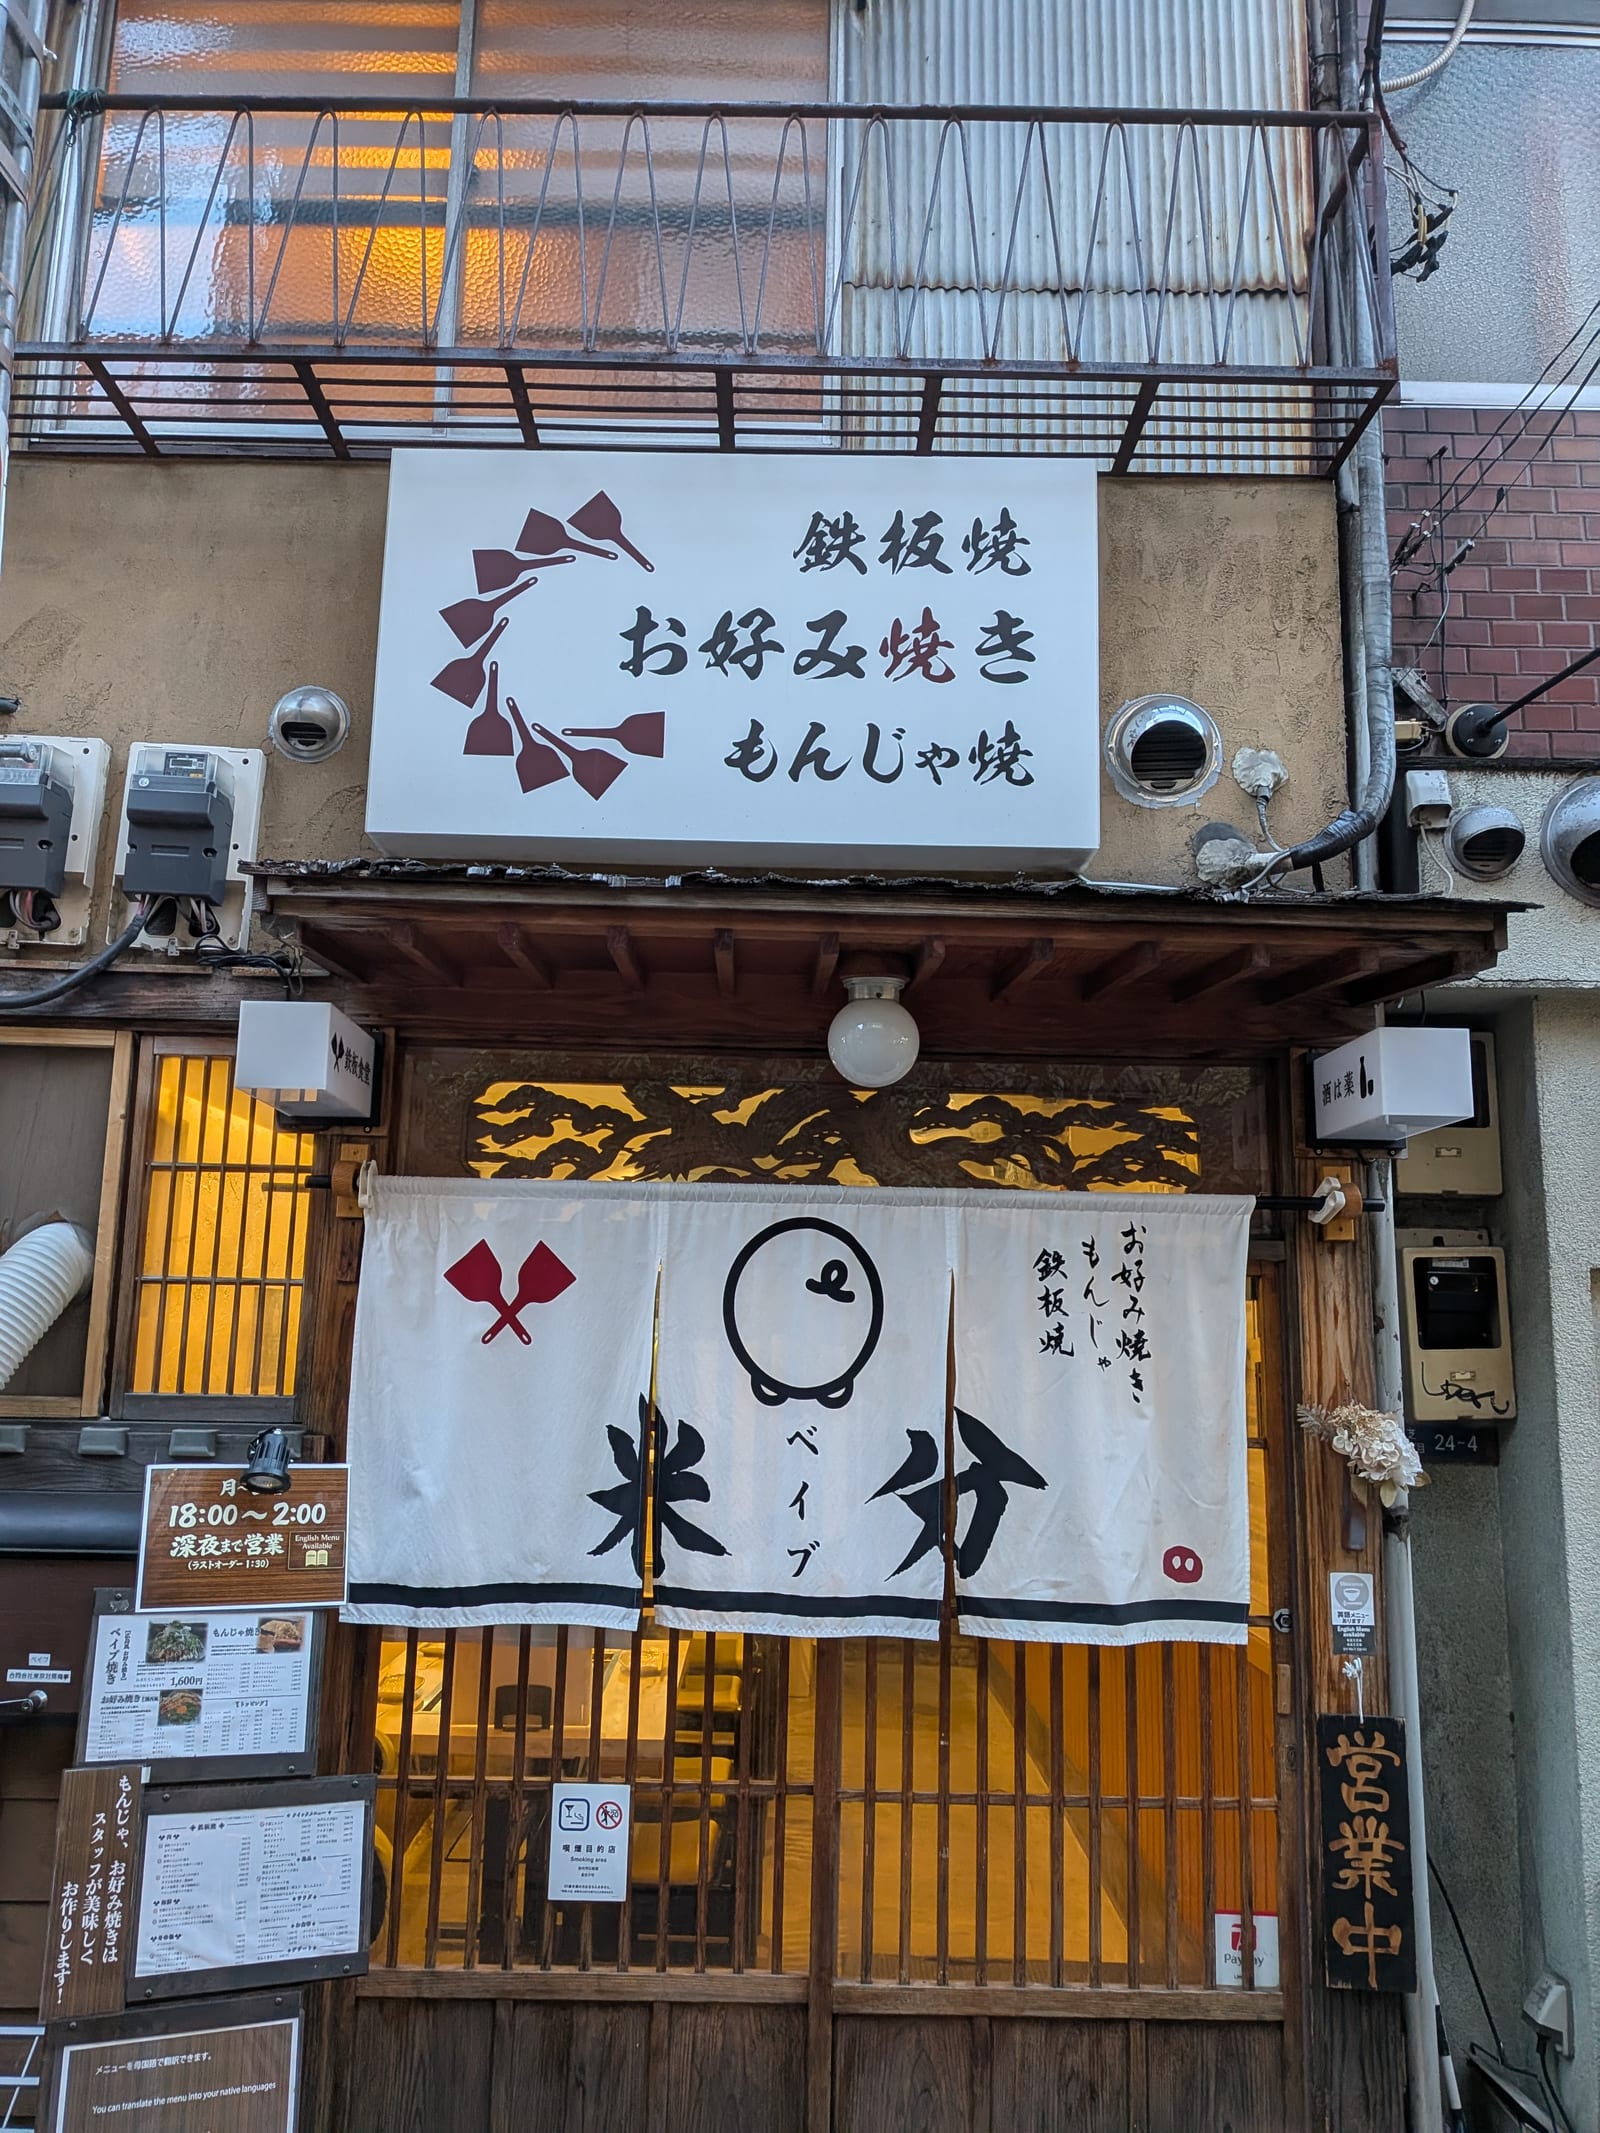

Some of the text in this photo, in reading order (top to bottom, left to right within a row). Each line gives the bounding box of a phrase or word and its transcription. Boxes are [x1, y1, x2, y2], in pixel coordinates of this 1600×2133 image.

[794, 507, 1032, 576] 鉄板焼
[619, 605, 1036, 684] お好み焼き
[724, 718, 1036, 788] もんじゃ焼
[344, 1047, 371, 1086] 鉄板食堂
[1321, 1070, 1355, 1107] 酒は薬
[1032, 1247, 1075, 1358] 鉄板焼
[1081, 1234, 1113, 1372] もんじゃ
[1434, 1433, 1478, 1452] 24-4
[786, 1425, 820, 1578] ベイブ
[169, 1532, 285, 1558] 深夜まで営業
[295, 1534, 319, 1543] English
[302, 1542, 333, 1550] Available
[170, 1676, 203, 1687] 1,600円
[562, 1844, 616, 1854] 喫煙目的店
[1326, 1730, 1405, 1990] 営業中
[80, 1812, 107, 1966] スタッフが美味しく
[92, 2081, 276, 2114] You can translate the menu into your native languages
